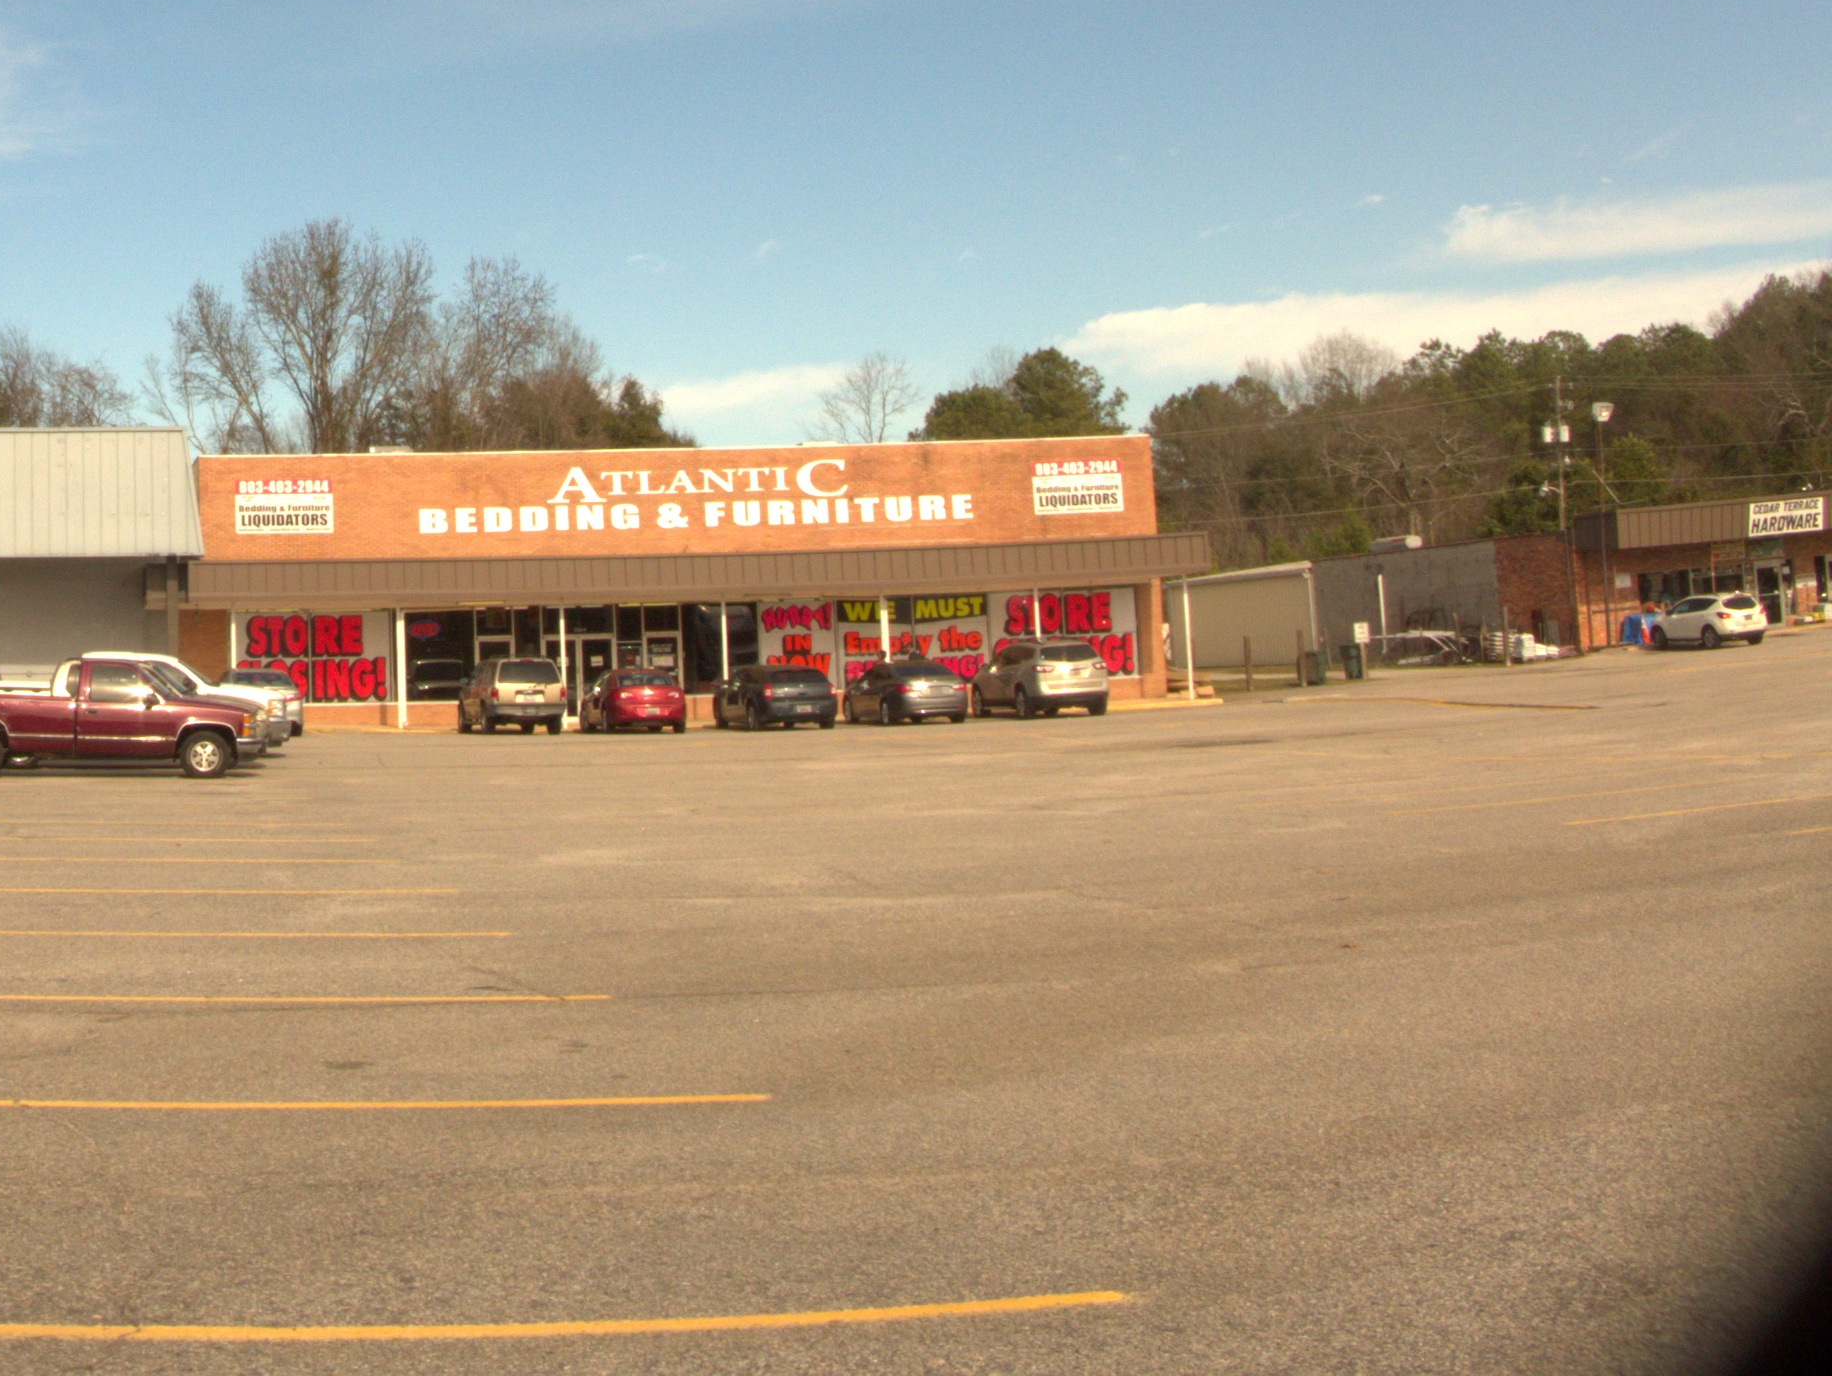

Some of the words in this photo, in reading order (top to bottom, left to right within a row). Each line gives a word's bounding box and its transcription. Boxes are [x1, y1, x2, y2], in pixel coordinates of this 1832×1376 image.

[1034, 459, 1118, 476] 803-403-2944
[238, 479, 330, 494] 803-403-2944
[546, 459, 849, 503] ATLANTIC
[1036, 486, 1072, 494] Bedding
[1080, 484, 1120, 492] Furniture
[238, 505, 277, 513] Bedding
[287, 504, 331, 512] Furniture
[1039, 492, 1119, 508] LIQUIDATORS
[1752, 503, 1781, 515] CEDAR
[1783, 498, 1820, 512] TERRACE
[241, 513, 328, 528] LIQUIDATORS
[418, 502, 641, 535] BEDDING
[656, 502, 689, 529] &
[704, 493, 974, 528] FURNITURE
[1751, 512, 1821, 534] HARDWARE
[843, 600, 896, 622] WE
[915, 596, 984, 620] MUST
[1005, 592, 1113, 635] STORE
[247, 614, 364, 656] STORE
[783, 634, 812, 654] IN
[938, 625, 983, 652] the
[237, 656, 387, 701] SING!
